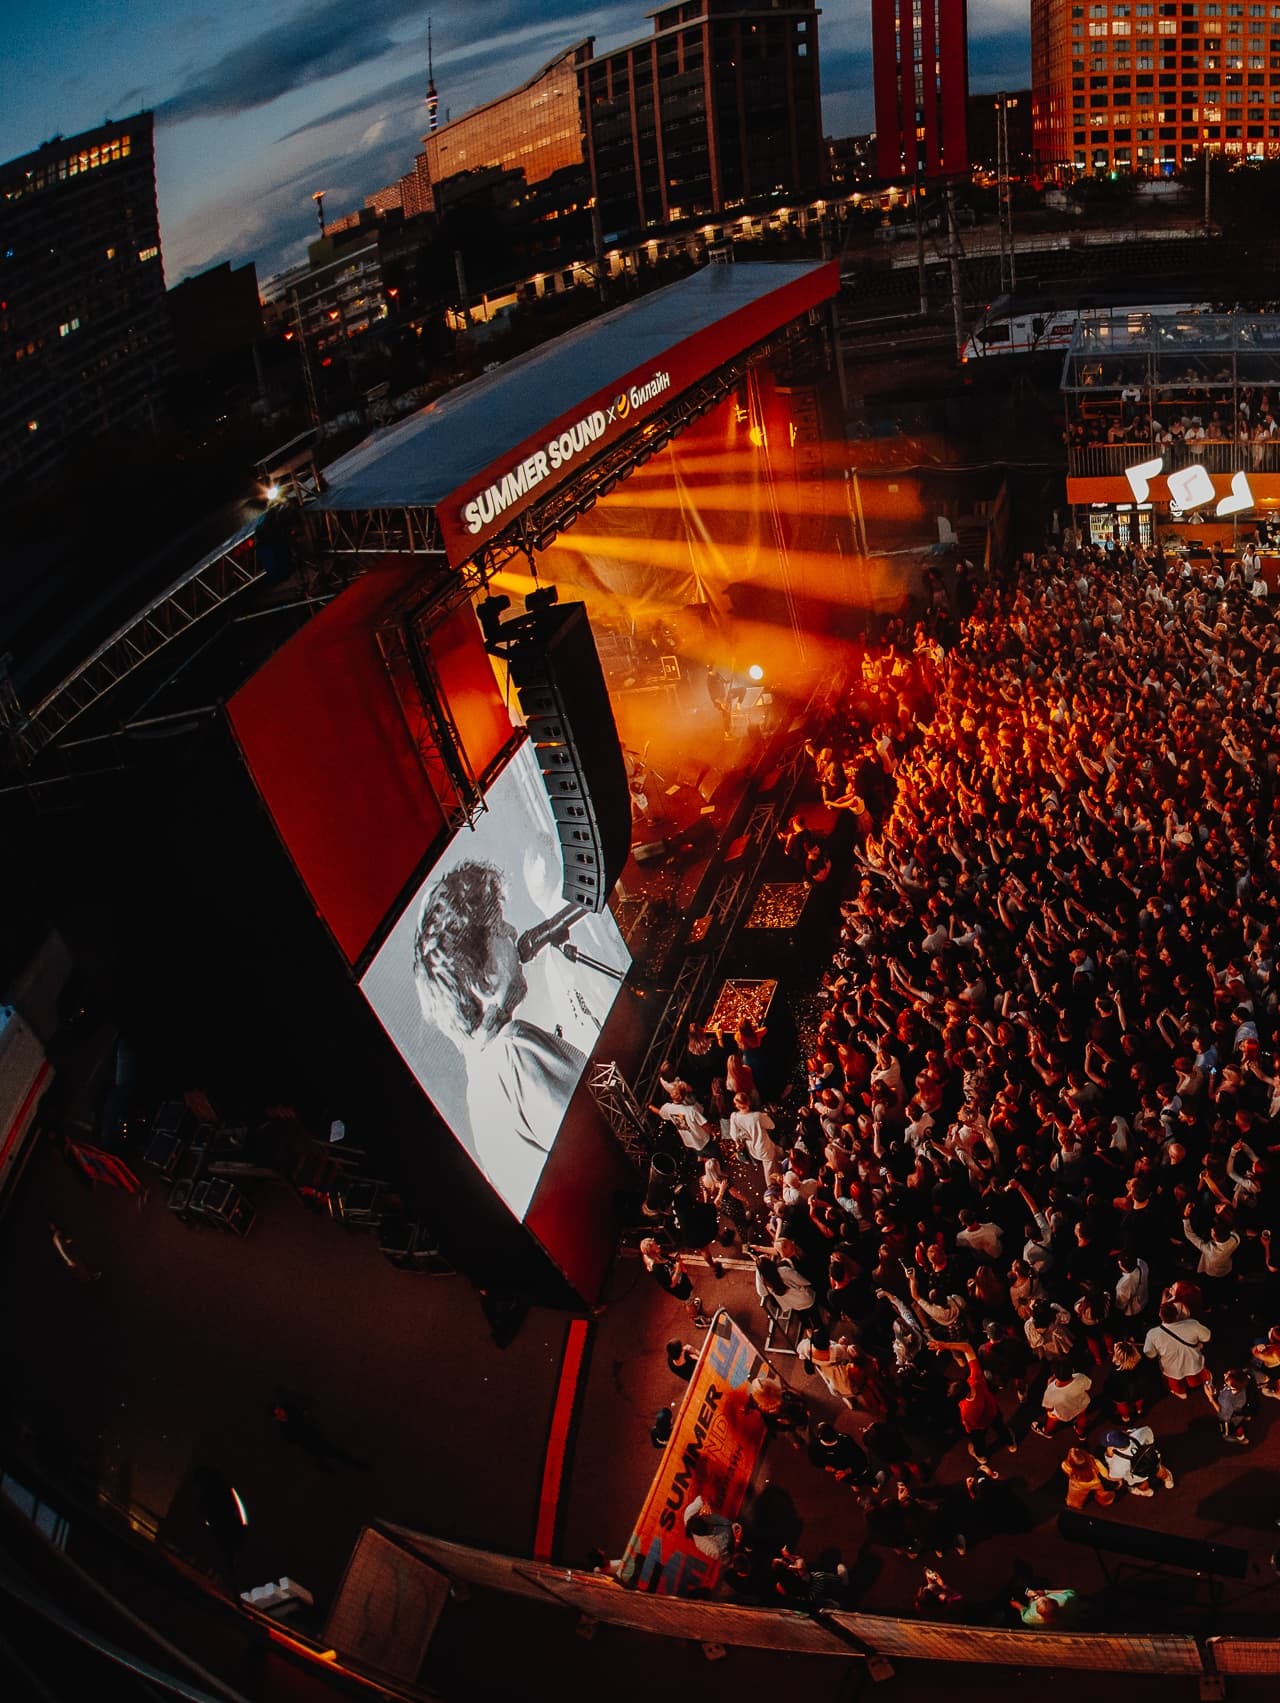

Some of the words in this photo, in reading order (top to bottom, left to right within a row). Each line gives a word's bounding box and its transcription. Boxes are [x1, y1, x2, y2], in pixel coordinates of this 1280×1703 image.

[464, 450, 551, 534] SUMMER
[548, 411, 606, 469] SOUND
[630, 371, 670, 409] билайн
[659, 1383, 723, 1532] SUMMER
